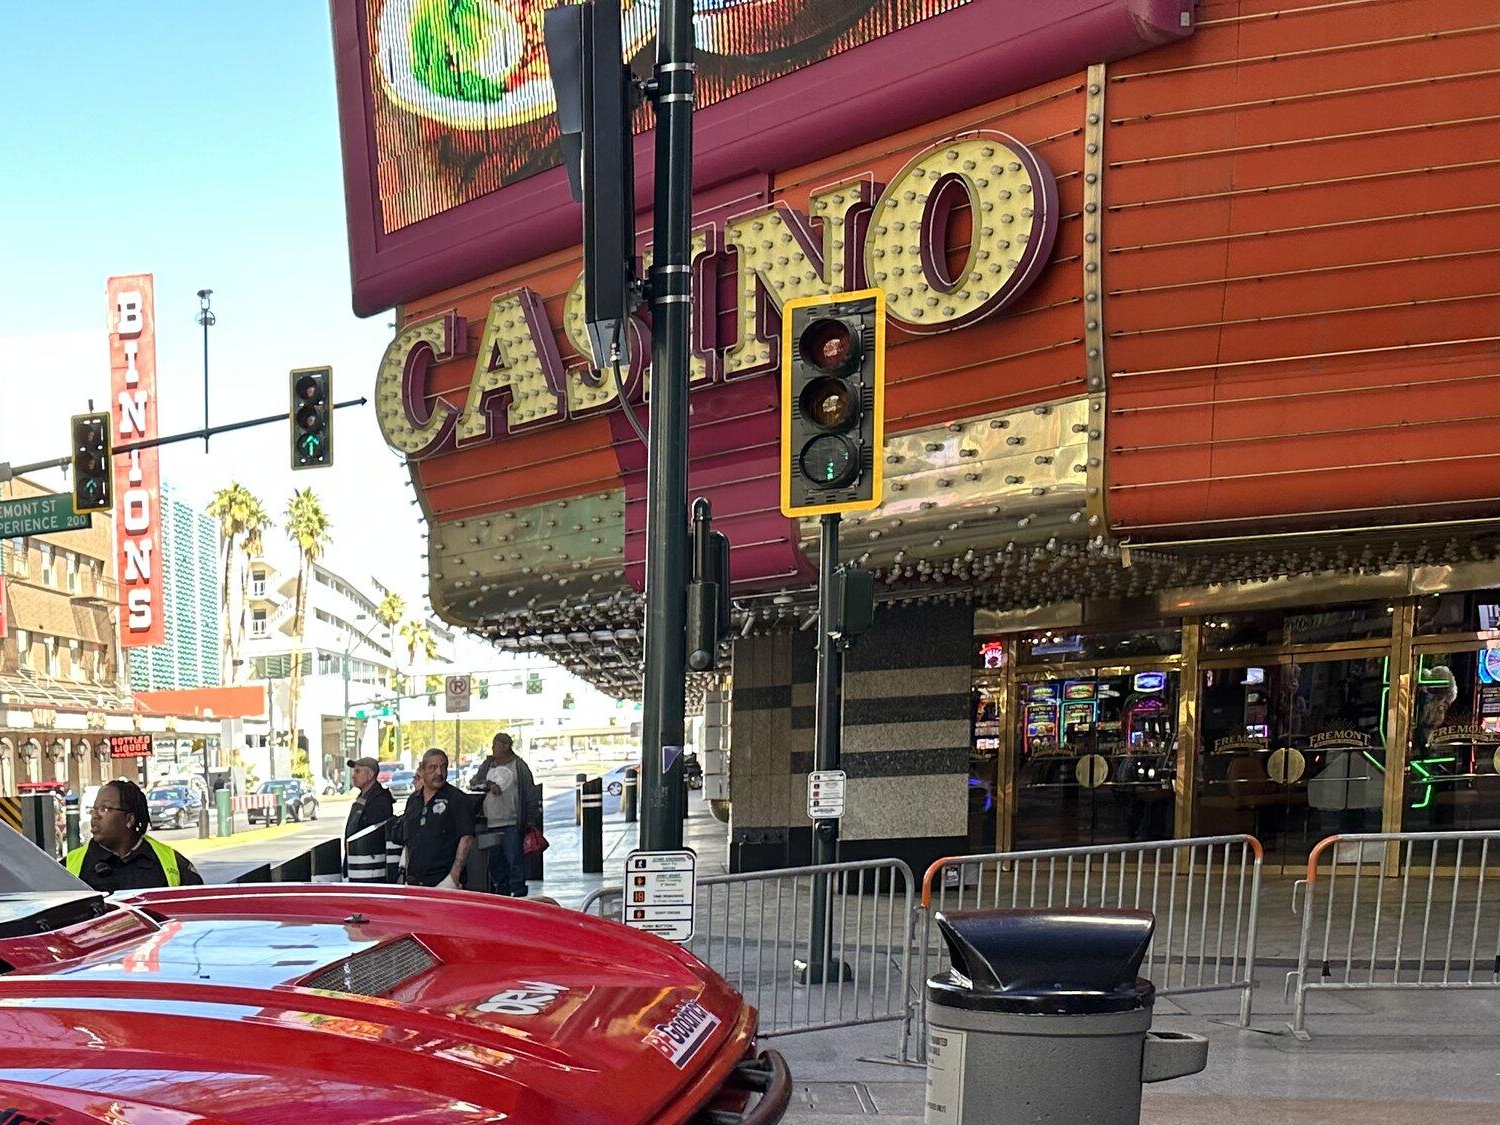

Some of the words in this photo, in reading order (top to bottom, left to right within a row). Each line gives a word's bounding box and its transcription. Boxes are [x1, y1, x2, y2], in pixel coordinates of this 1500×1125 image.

[117, 289, 153, 635] BINIONS
[41, 500, 57, 513] ST
[66, 514, 87, 527] 200
[1309, 729, 1373, 748] FREMONT
[474, 979, 572, 1016] ORW
